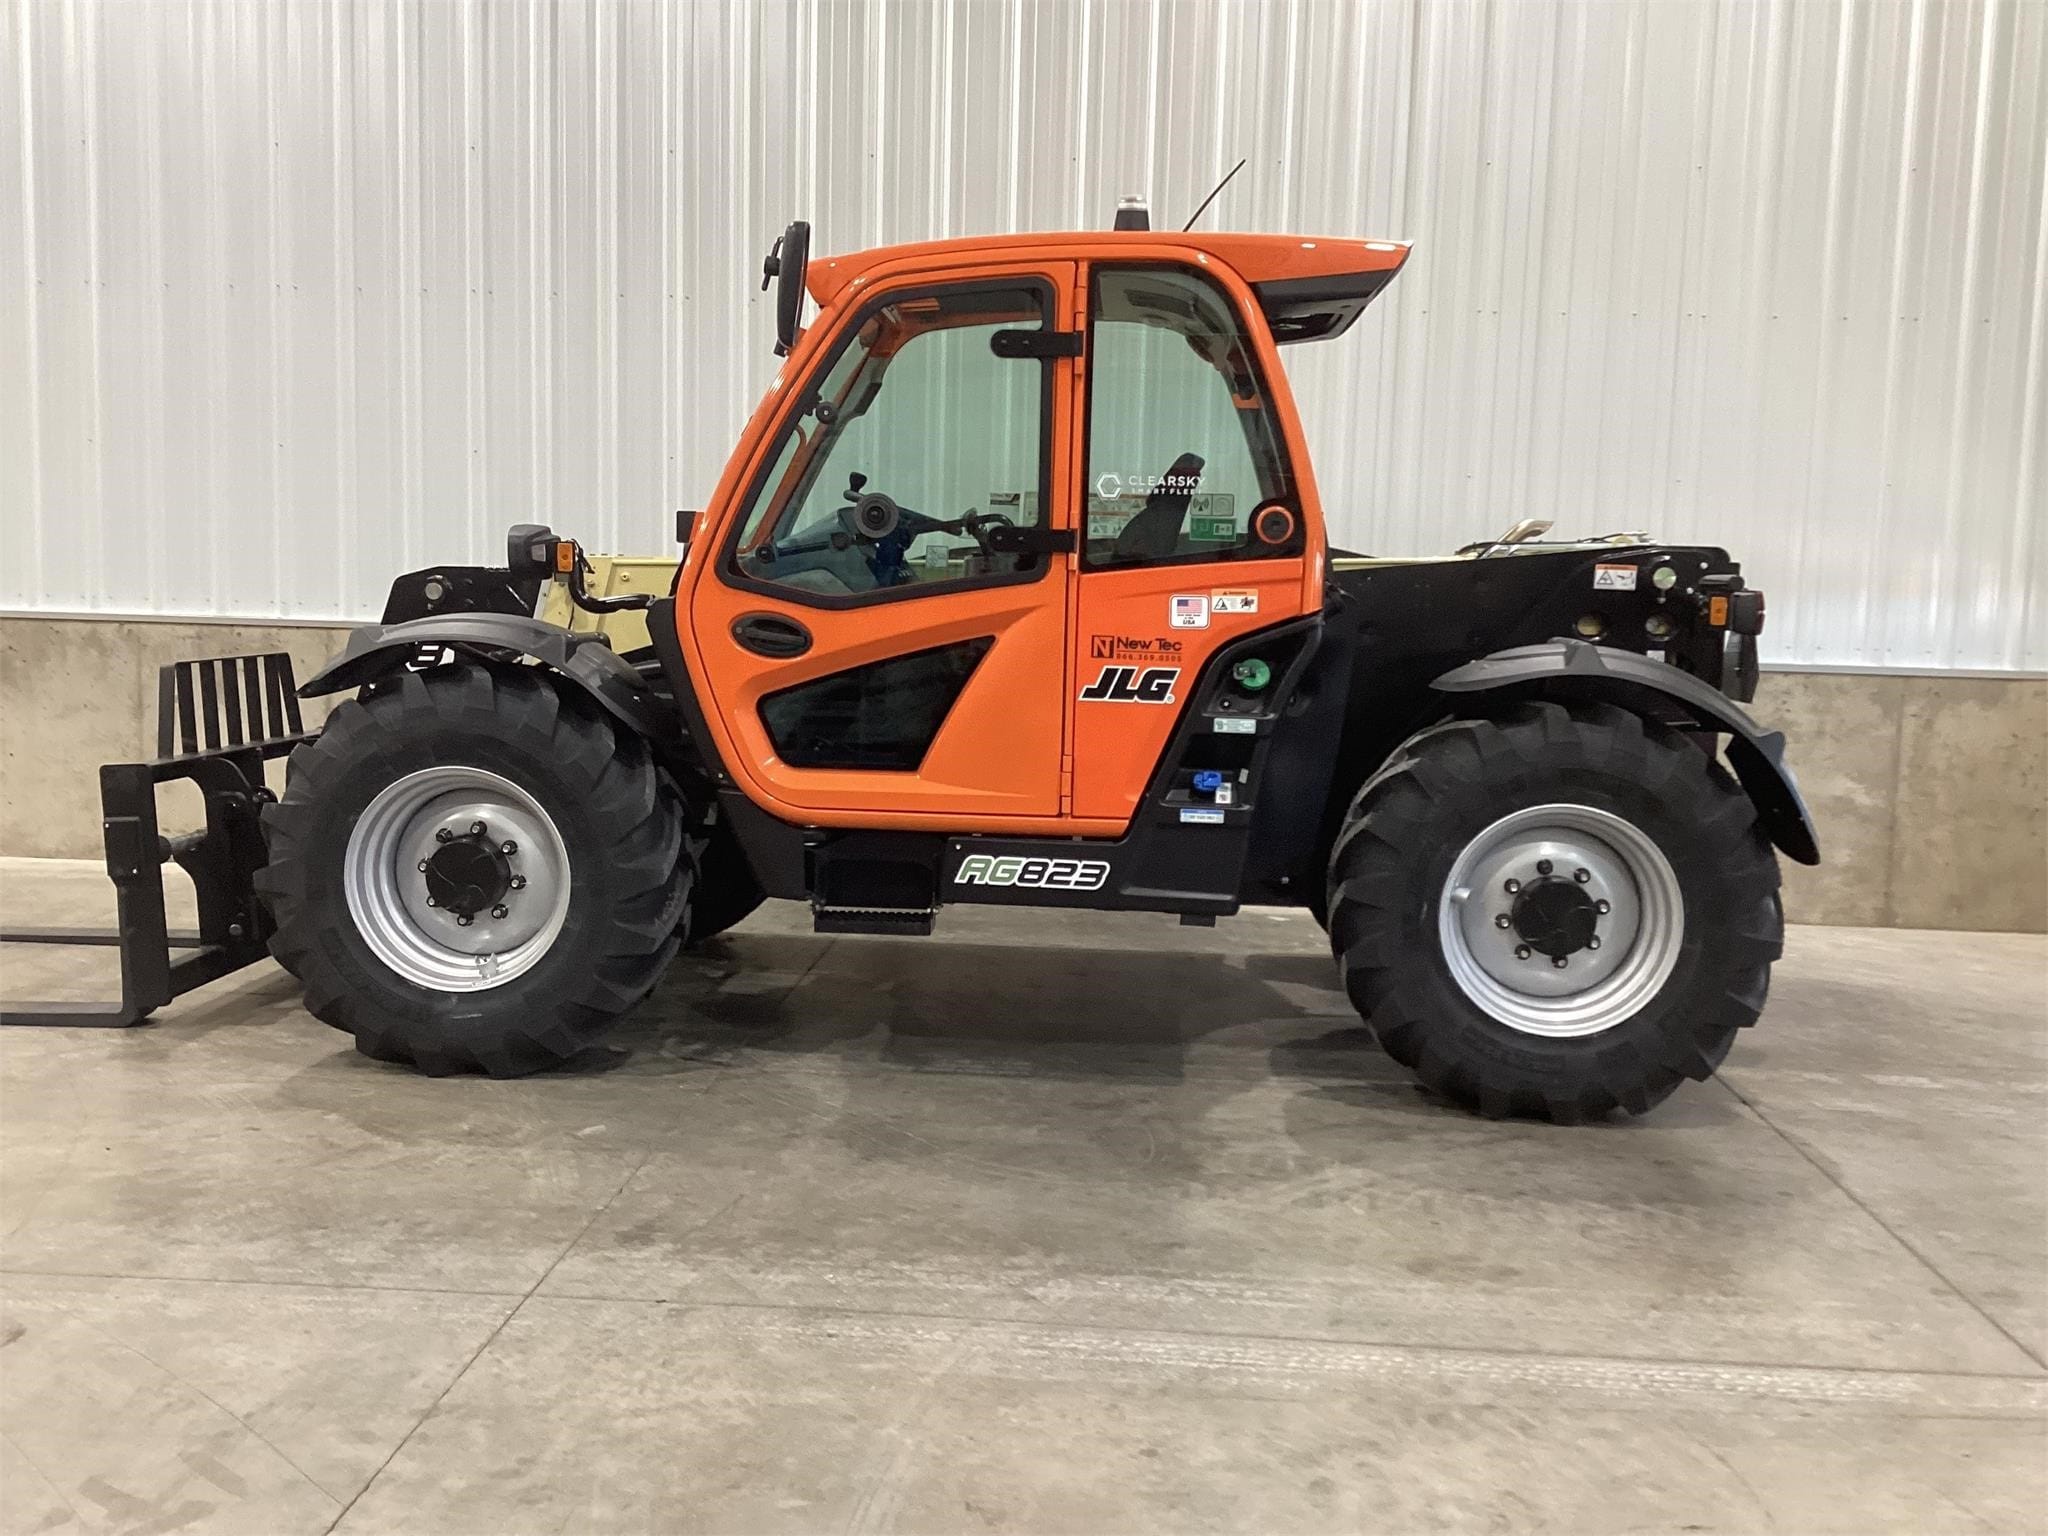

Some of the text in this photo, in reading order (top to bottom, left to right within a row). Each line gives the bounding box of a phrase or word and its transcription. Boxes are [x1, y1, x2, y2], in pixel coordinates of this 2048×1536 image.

[1128, 475, 1205, 487] CLEARSKY
[1117, 636, 1182, 651] New Tec
[1080, 665, 1181, 704] JLG
[954, 854, 1111, 891] AG823
